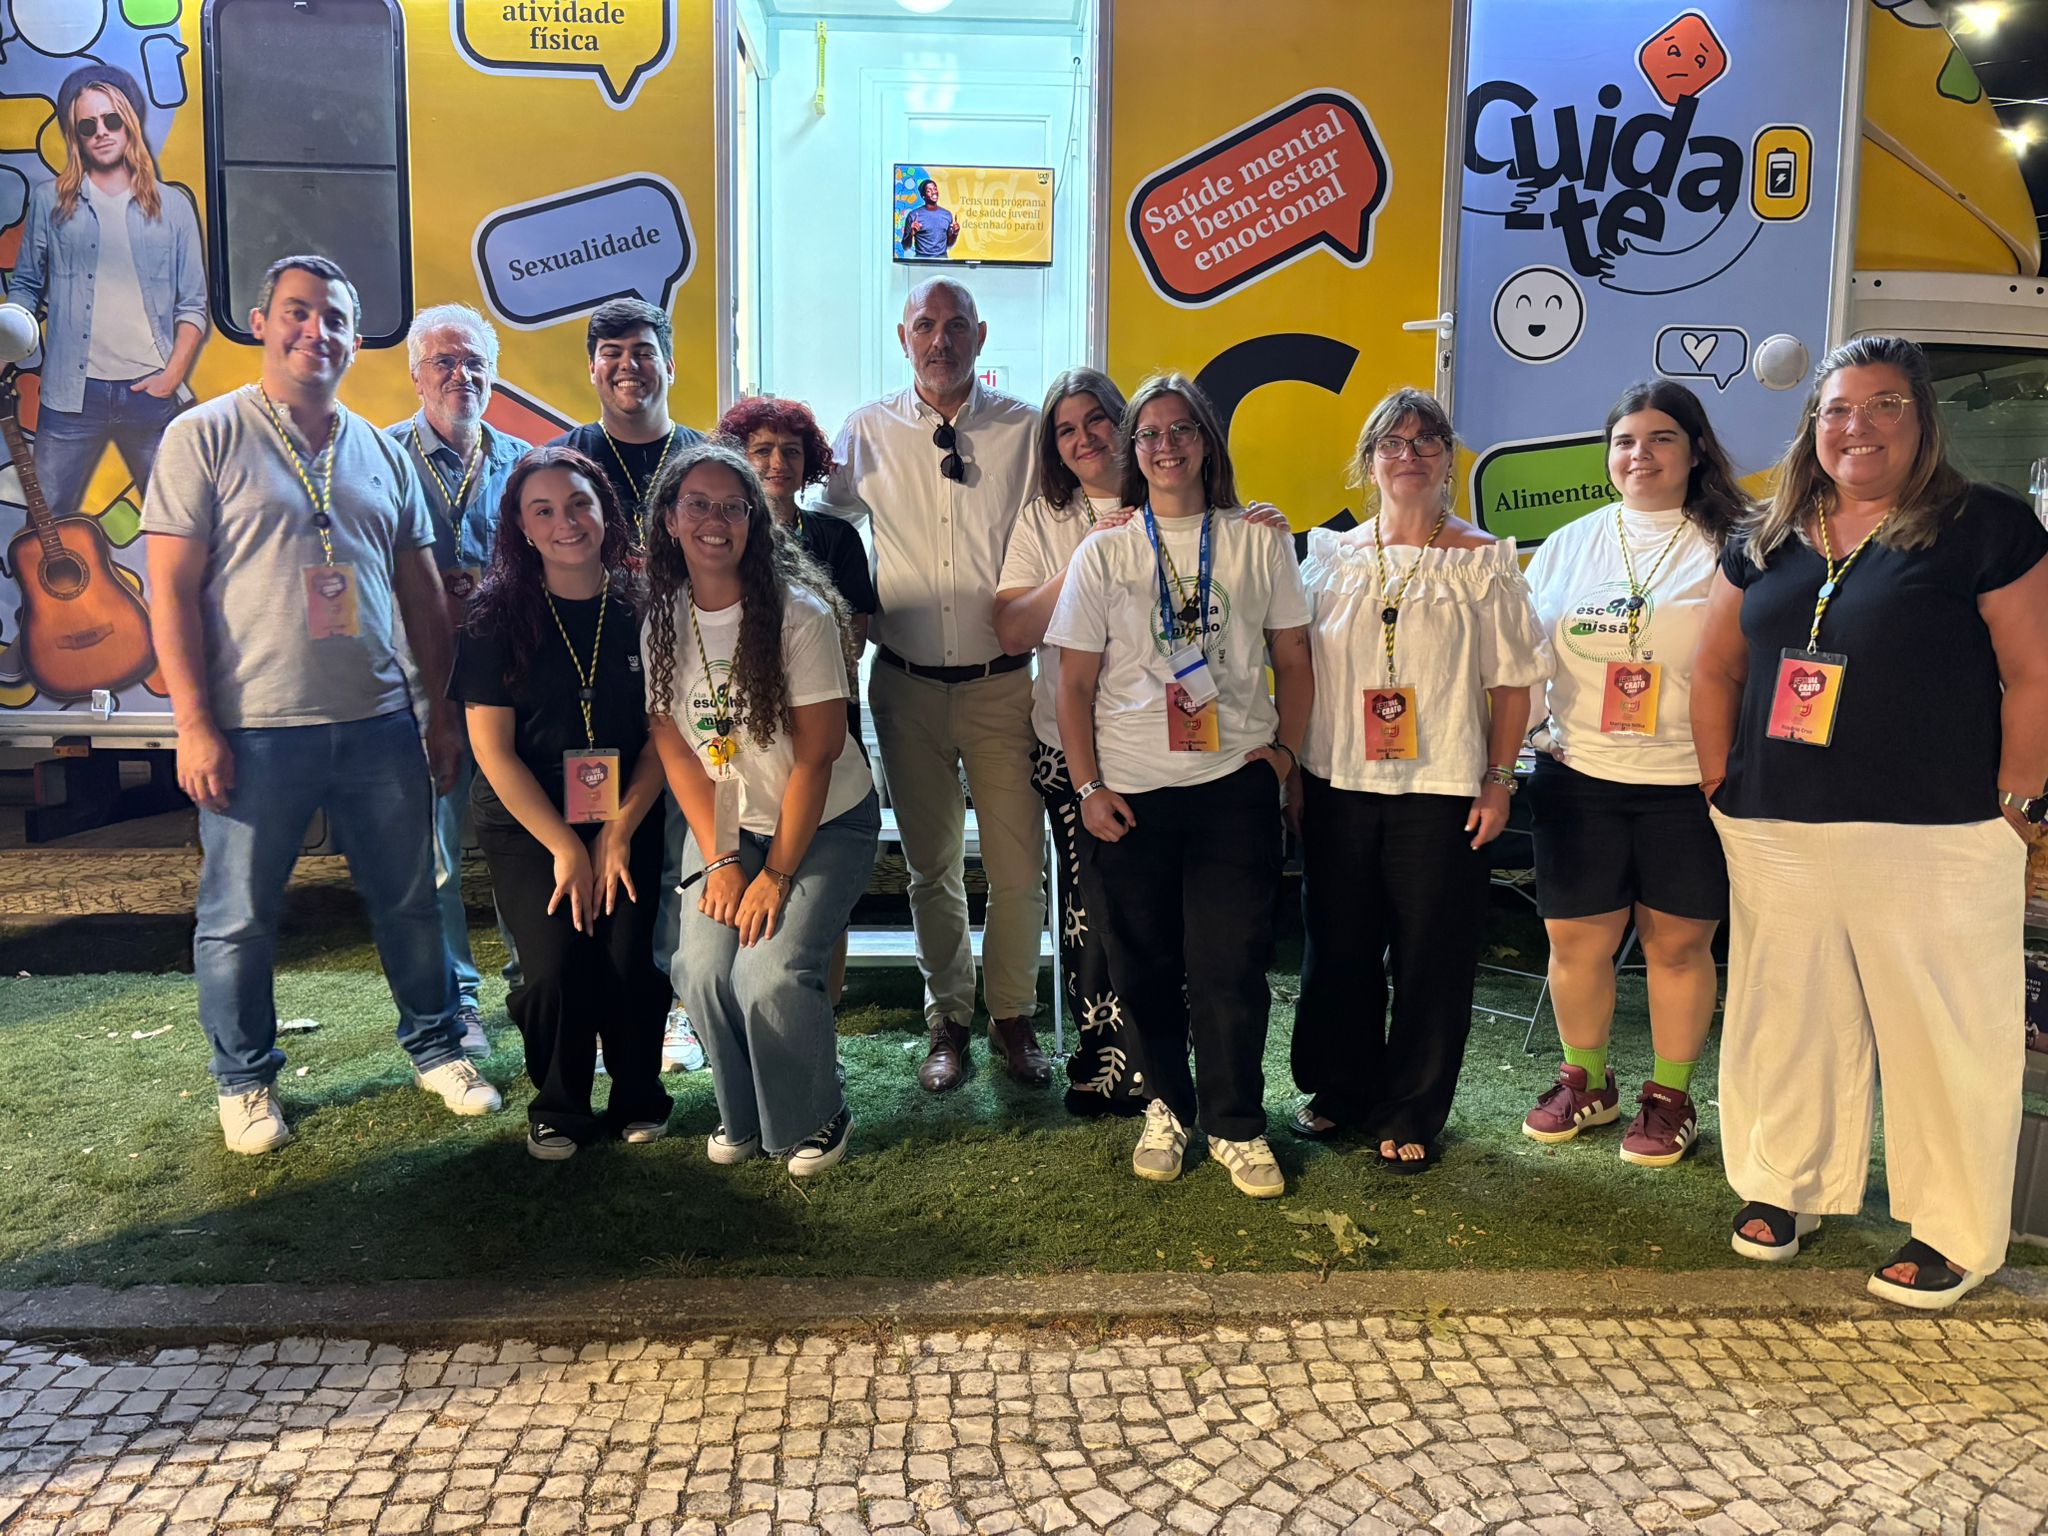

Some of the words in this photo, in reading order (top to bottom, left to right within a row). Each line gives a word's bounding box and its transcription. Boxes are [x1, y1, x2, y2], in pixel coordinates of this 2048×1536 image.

[502, 0, 626, 25] atividade
[529, 26, 600, 52] física
[1463, 80, 1744, 214] Cuida
[1144, 176, 1236, 234] Saúde
[1237, 108, 1346, 186] mental
[959, 196, 982, 206] Tens
[983, 198, 1000, 206] um
[1001, 198, 1047, 210] programa
[1173, 229, 1193, 250] e
[1190, 148, 1342, 240] bem-estar
[962, 218, 1013, 230] desenhado
[1014, 221, 1036, 232] para
[966, 206, 978, 217] de
[979, 207, 1007, 218] saúde
[1008, 208, 1041, 221] juvenil
[1194, 172, 1348, 271] emocional
[508, 225, 662, 281] Sexualidade
[1494, 481, 1623, 513] Alimentaç
[1624, 680, 1646, 689] CRATO
[1798, 683, 1820, 692] CRATO
[1381, 705, 1402, 715] CRATO
[585, 773, 604, 782] CRATO
